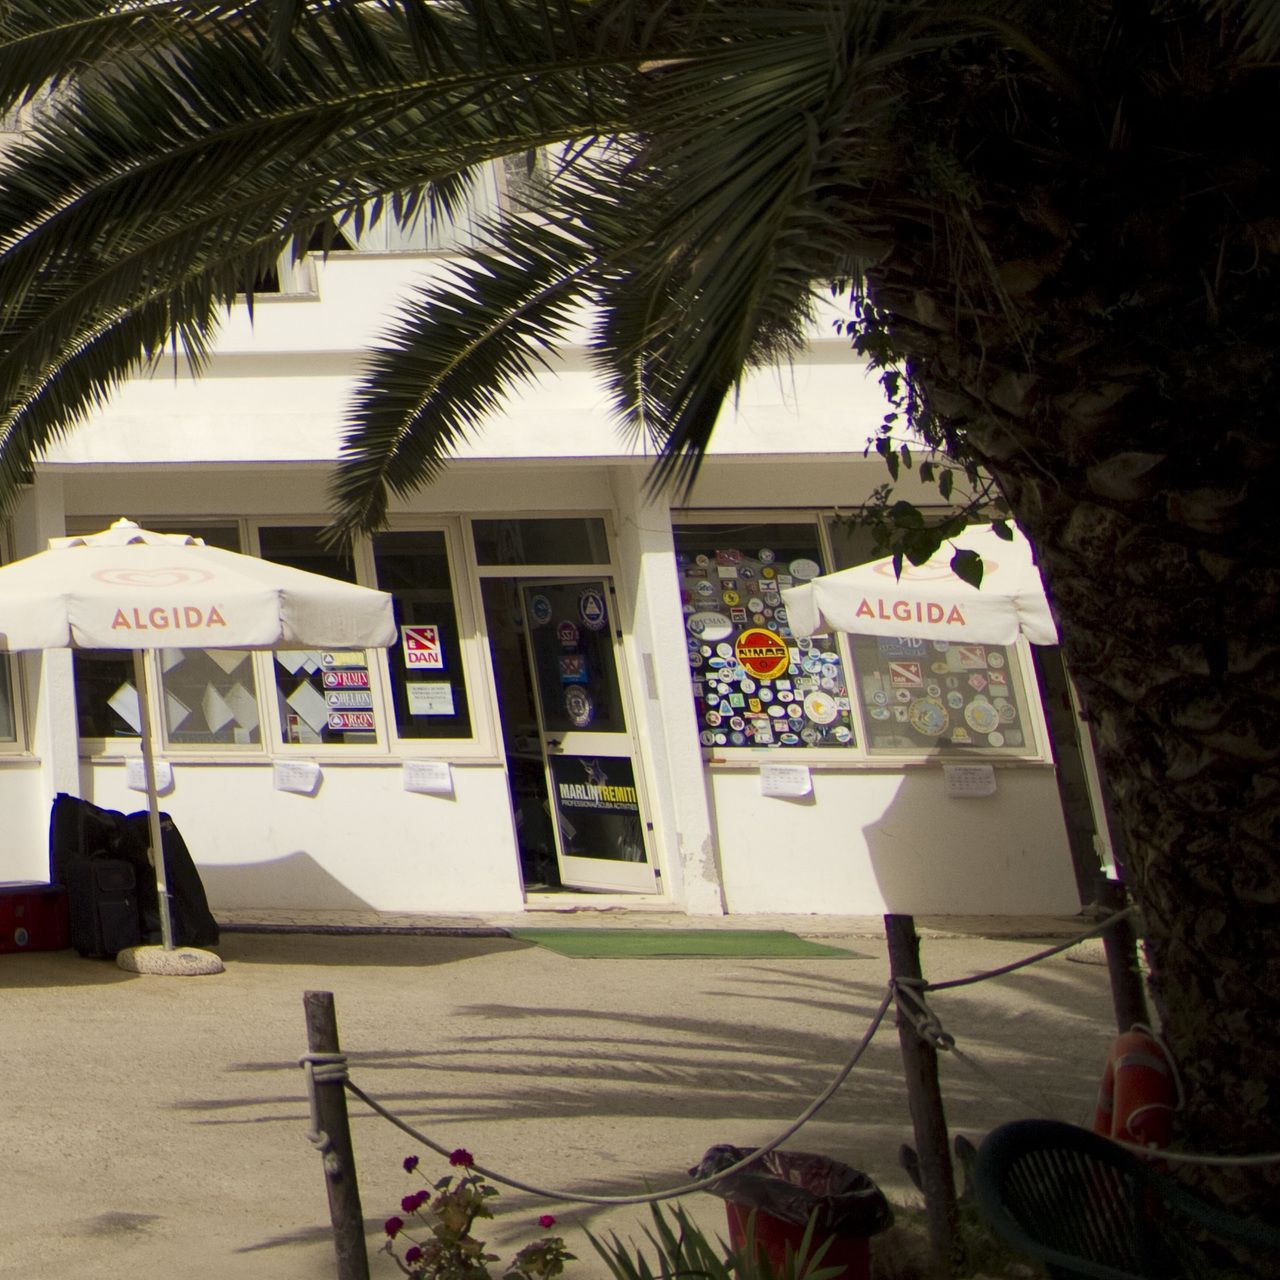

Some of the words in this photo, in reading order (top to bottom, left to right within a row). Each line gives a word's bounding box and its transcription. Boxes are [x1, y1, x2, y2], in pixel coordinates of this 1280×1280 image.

[111, 605, 227, 630] ALGIDA
[855, 597, 966, 626] ALGIDA
[408, 652, 439, 664] DAN
[738, 648, 786, 657] NIMAR
[343, 713, 372, 725] ARGON
